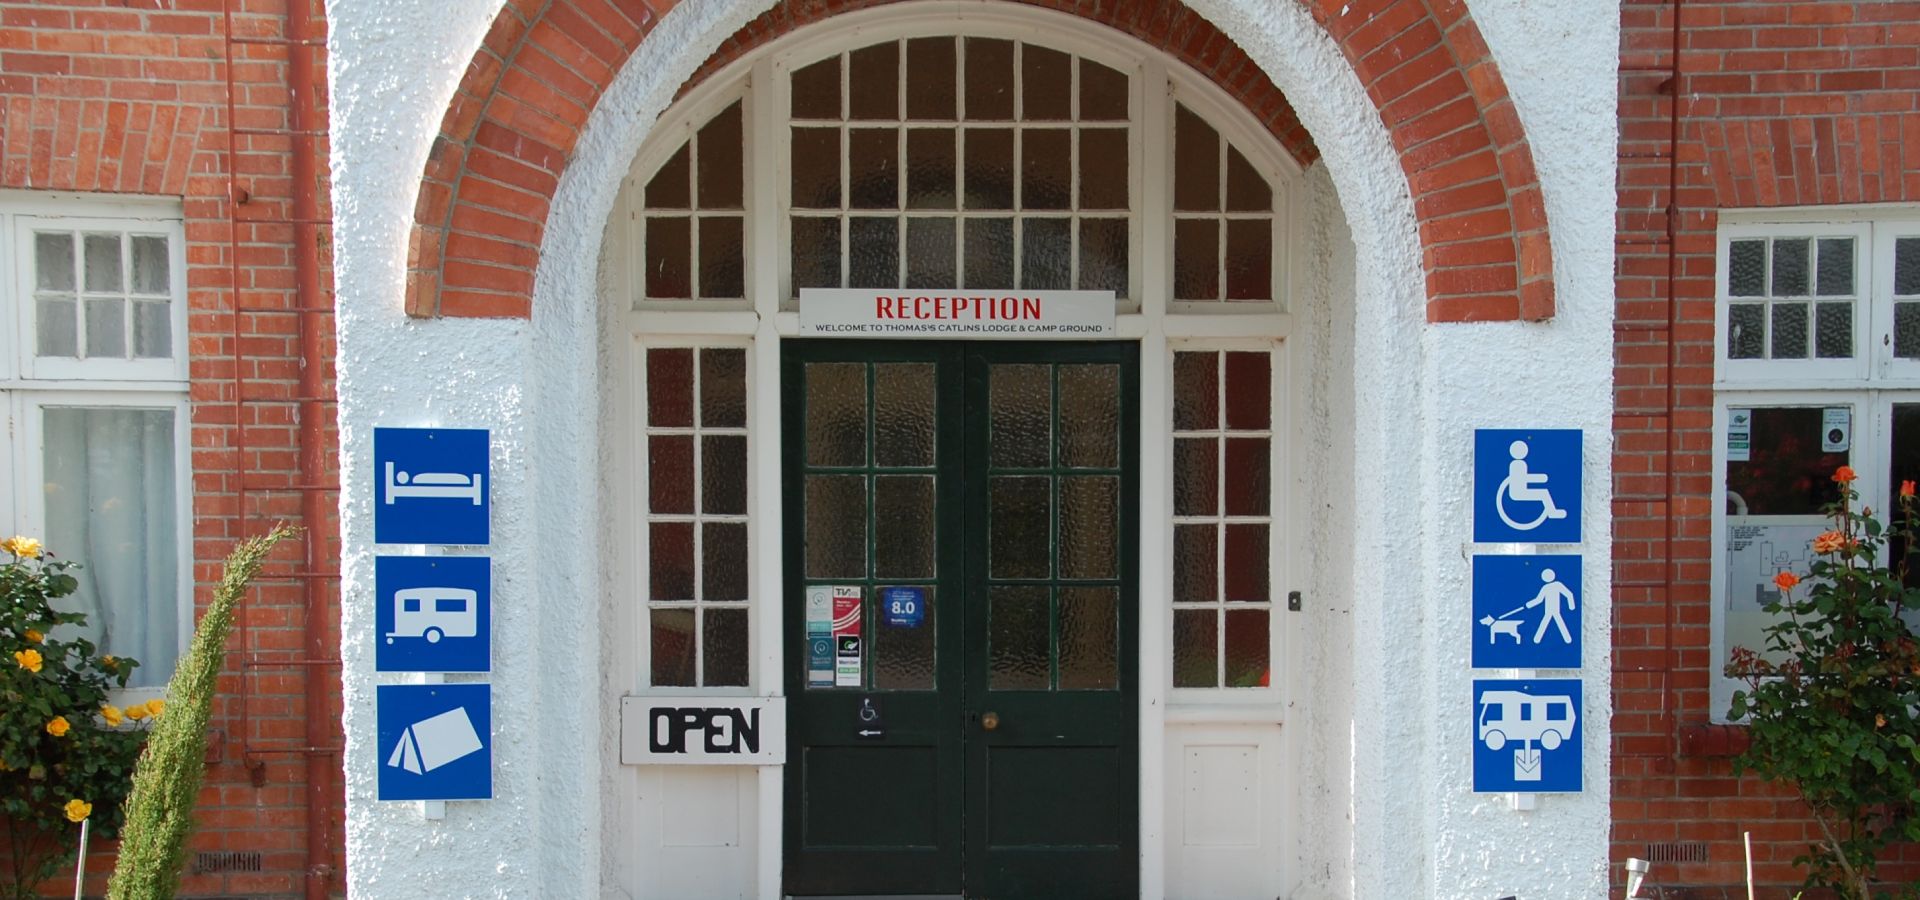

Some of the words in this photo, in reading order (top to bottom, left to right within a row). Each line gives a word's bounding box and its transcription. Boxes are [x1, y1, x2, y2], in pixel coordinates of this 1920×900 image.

[875, 296, 1041, 321] RECEPTION
[815, 324, 867, 332] WELCOME
[870, 324, 883, 332] TO
[885, 324, 936, 332] THOMAS'S
[938, 324, 981, 332] CATLINS
[982, 324, 1019, 332] LODGE
[1019, 324, 1026, 332] &
[1027, 324, 1058, 332] CAMP
[1059, 324, 1103, 333] GROUND
[891, 601, 915, 614] 8.0
[649, 707, 761, 754] OPEN
